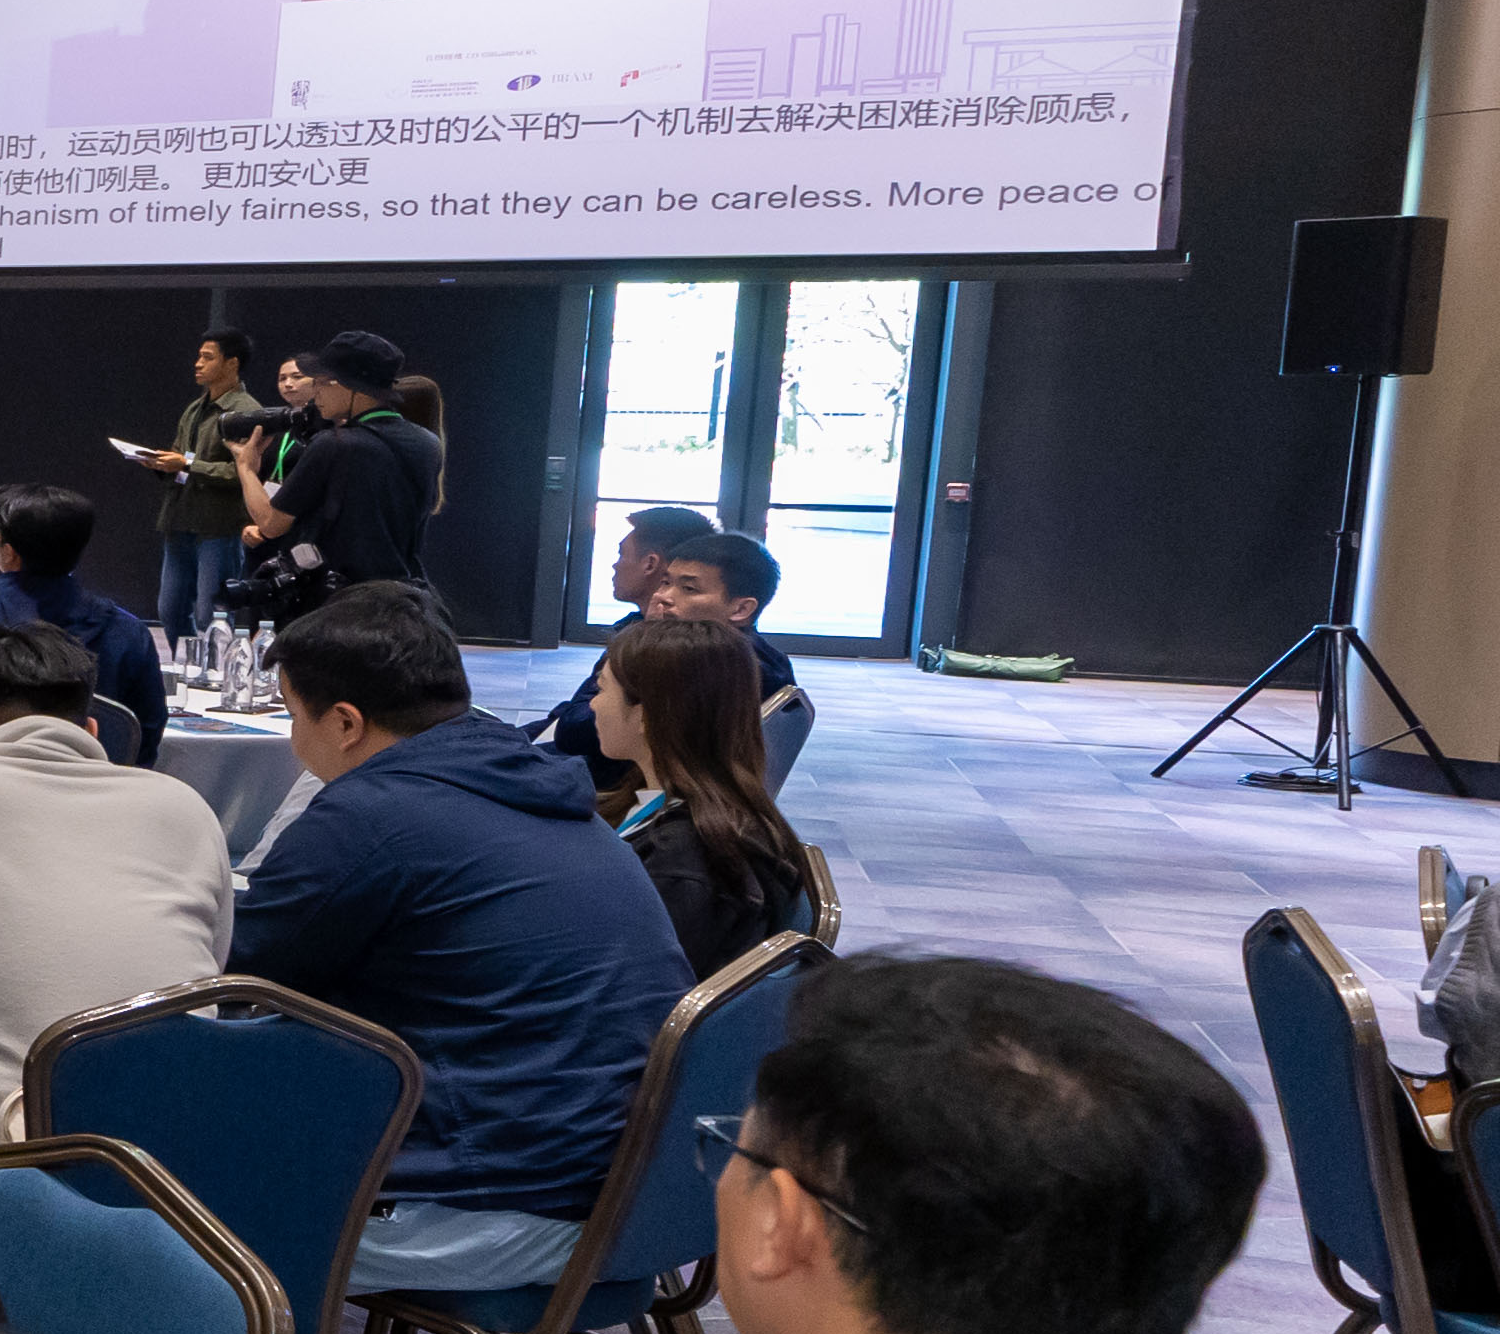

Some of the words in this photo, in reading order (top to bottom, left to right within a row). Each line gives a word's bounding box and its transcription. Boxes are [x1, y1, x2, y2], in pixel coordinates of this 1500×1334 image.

[200, 157, 371, 191] 更加安心更
[108, 200, 139, 224] of
[144, 198, 232, 228] timely
[240, 196, 370, 225] fairness,
[382, 195, 419, 218] so
[430, 192, 491, 217] that
[501, 190, 572, 220] they
[583, 191, 643, 215] can
[656, 187, 699, 213] be
[711, 184, 872, 211] careless.
[888, 180, 985, 208] More
[998, 180, 1119, 211] peace
[1133, 174, 1175, 203] of
